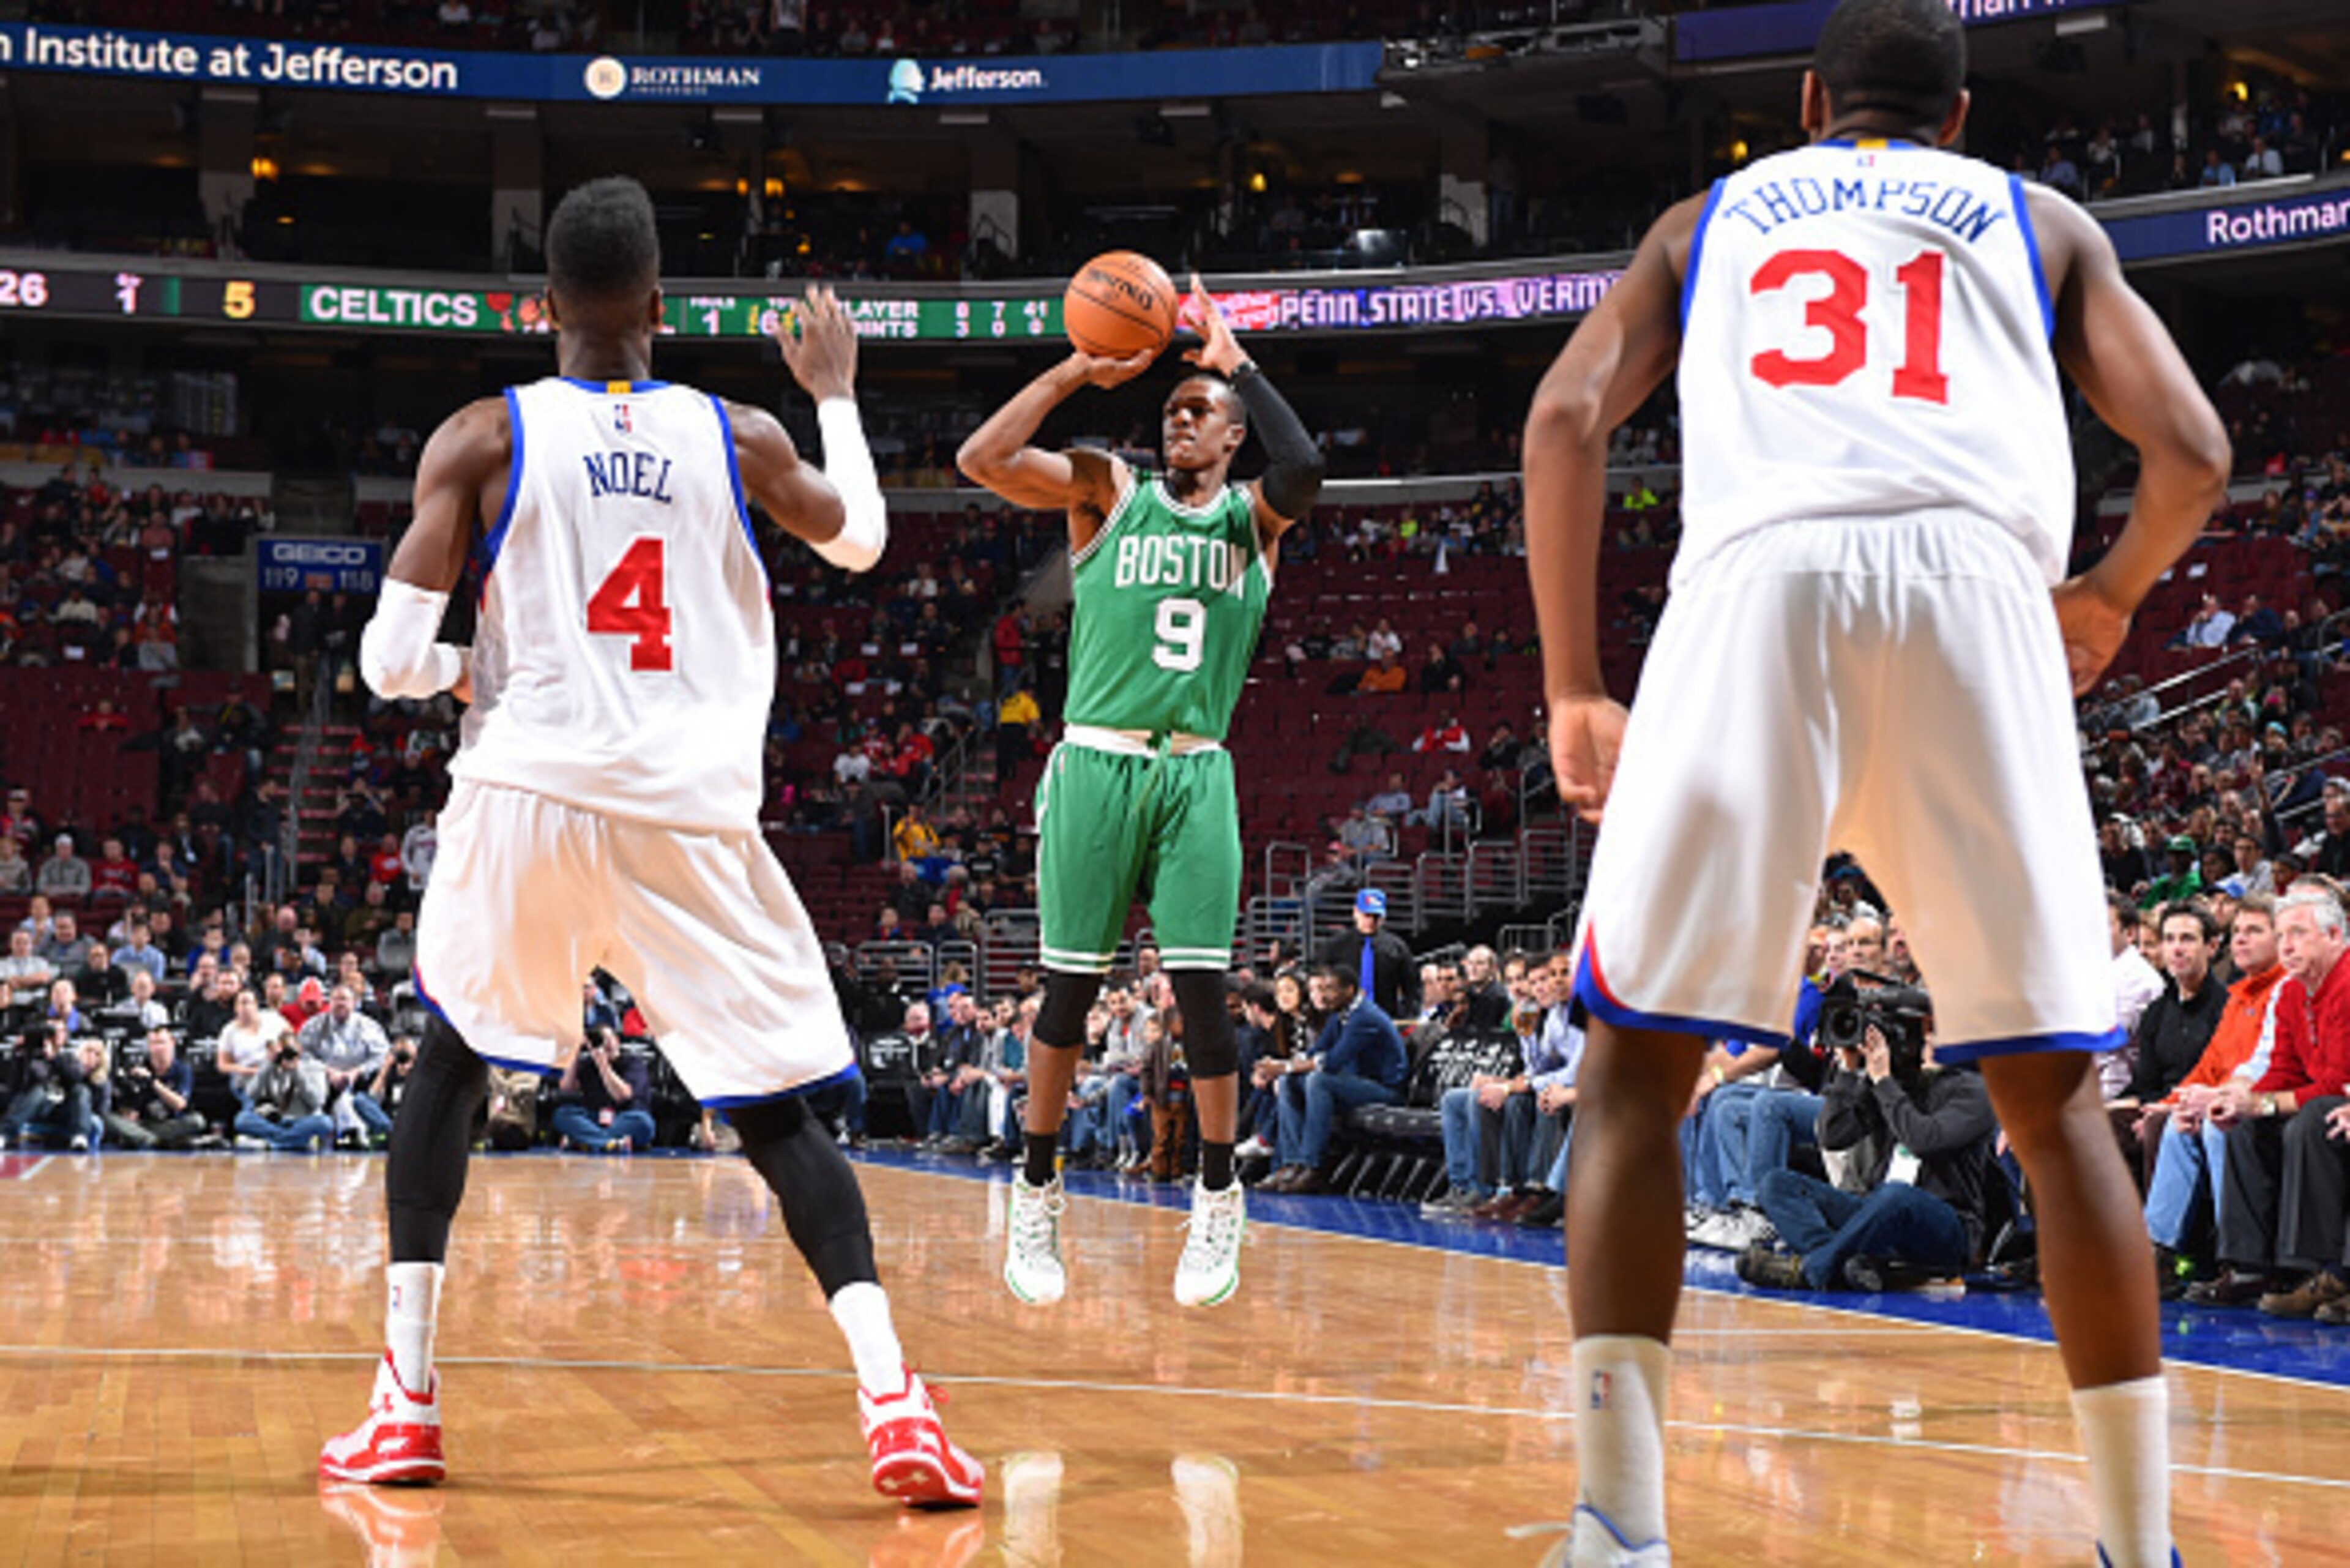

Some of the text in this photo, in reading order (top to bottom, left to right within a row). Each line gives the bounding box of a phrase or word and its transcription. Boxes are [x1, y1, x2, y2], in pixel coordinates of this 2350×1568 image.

[25, 27, 199, 75] Institute
[208, 42, 252, 77] at
[259, 43, 458, 89] Jefferson
[630, 66, 760, 85] ROTHMAN
[1722, 177, 2007, 244] THOMPSON
[223, 280, 256, 319] 5
[310, 286, 478, 327] CELTICS
[991, 301, 1006, 319] 7
[1368, 290, 1450, 323] STATE
[1516, 277, 1619, 313] VERM
[1750, 250, 1949, 405] 31
[583, 452, 673, 504] NOEL
[272, 543, 367, 566] GEICO
[1114, 534, 1245, 601] BOSTON
[586, 536, 673, 673] 4
[1151, 597, 1207, 671] 9
